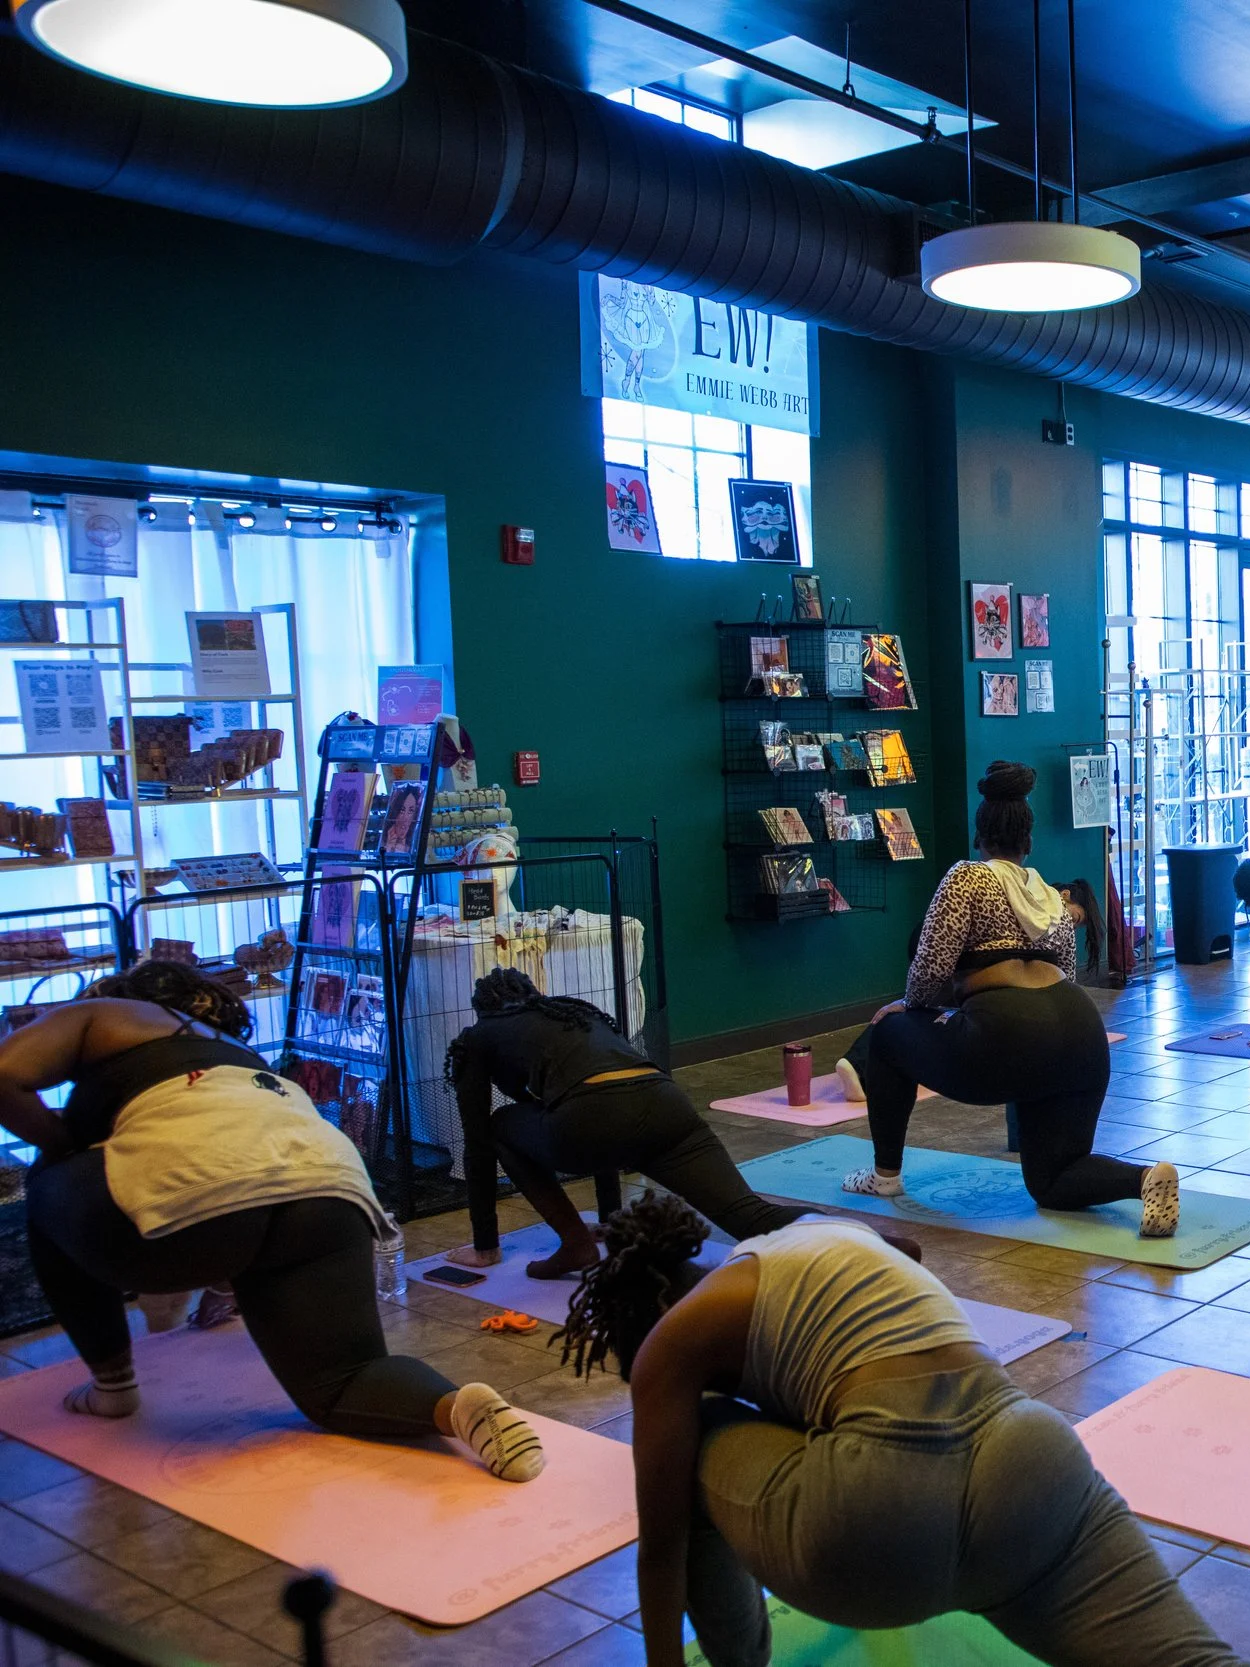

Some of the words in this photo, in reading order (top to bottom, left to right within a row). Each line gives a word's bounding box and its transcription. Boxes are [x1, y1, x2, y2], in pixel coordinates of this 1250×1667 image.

[692, 296, 773, 374] EW!
[686, 372, 734, 400] EMMIE
[739, 384, 778, 409] WEBB
[783, 392, 809, 415] ART
[831, 630, 847, 638] SCAN
[1089, 758, 1109, 778] EW!
